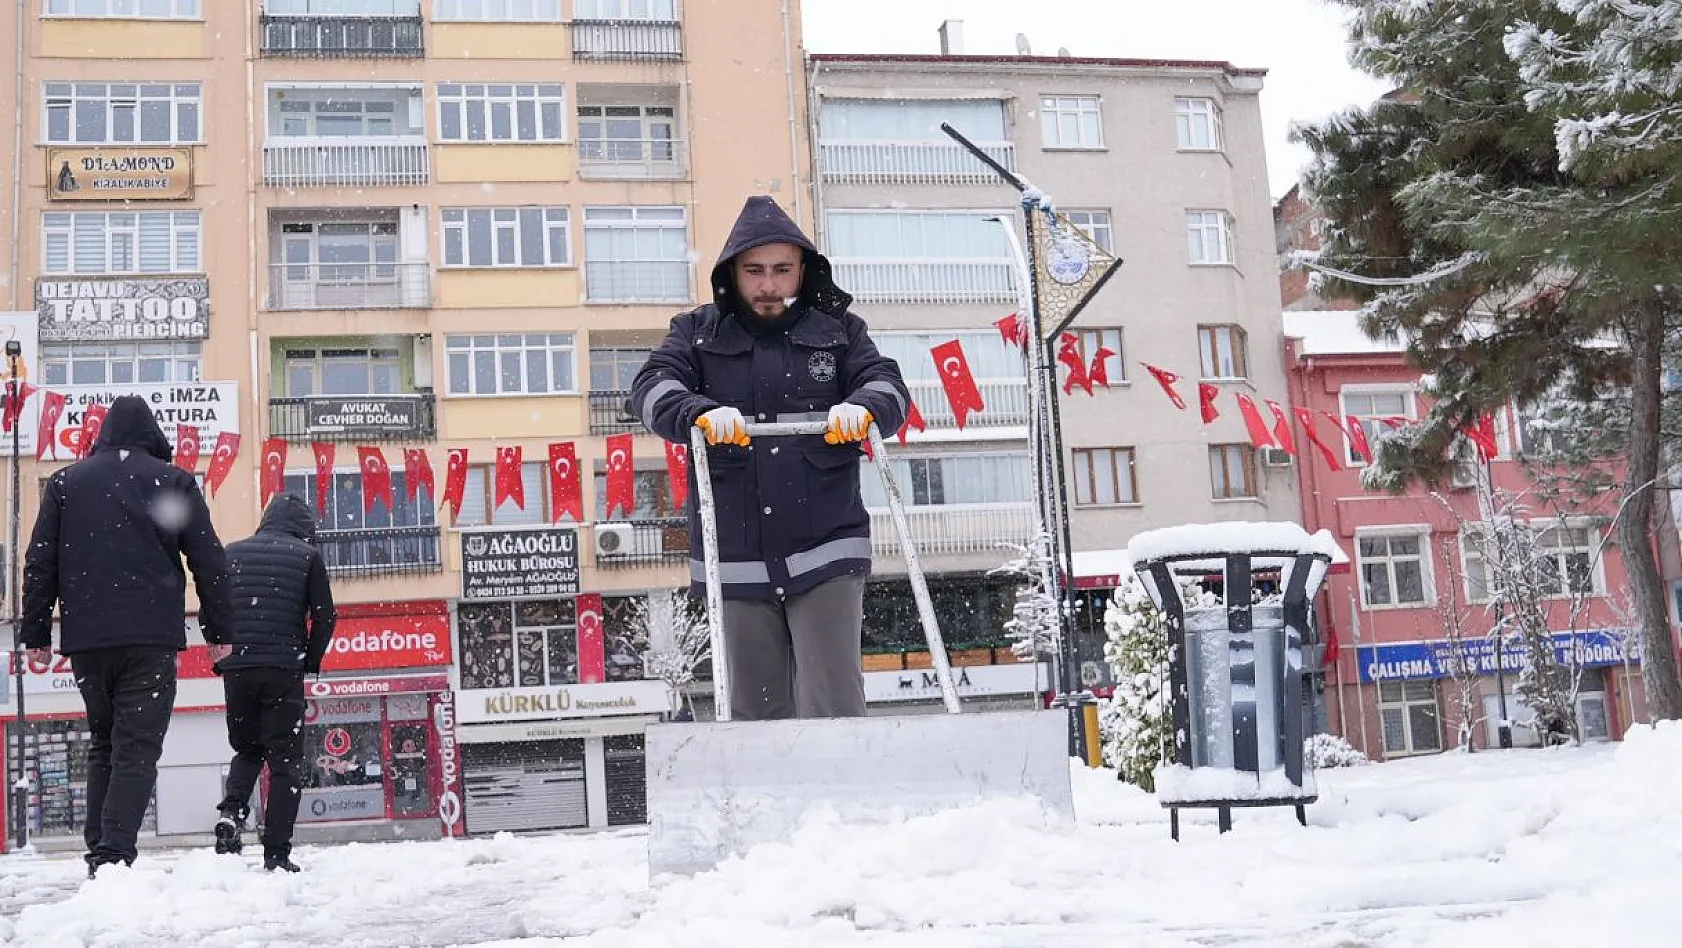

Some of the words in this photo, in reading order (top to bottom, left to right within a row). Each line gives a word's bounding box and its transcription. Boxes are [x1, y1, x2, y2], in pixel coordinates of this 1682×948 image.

[41, 281, 124, 298] DEJAVU
[49, 297, 197, 323] TATTOO
[319, 415, 367, 425] CEVHER
[367, 412, 410, 424] DOĞAN
[488, 532, 574, 556] AĞAOĞLU
[467, 558, 518, 573] HUKUK
[521, 554, 575, 571] BÜROSU
[525, 570, 577, 583] AĞAOĞLU
[1368, 659, 1433, 680] ÇALIŞMA
[333, 682, 390, 693] vodafone
[321, 700, 372, 717] vodafone
[485, 690, 571, 714] KÜRKLÜ
[440, 691, 457, 786] vodafone
